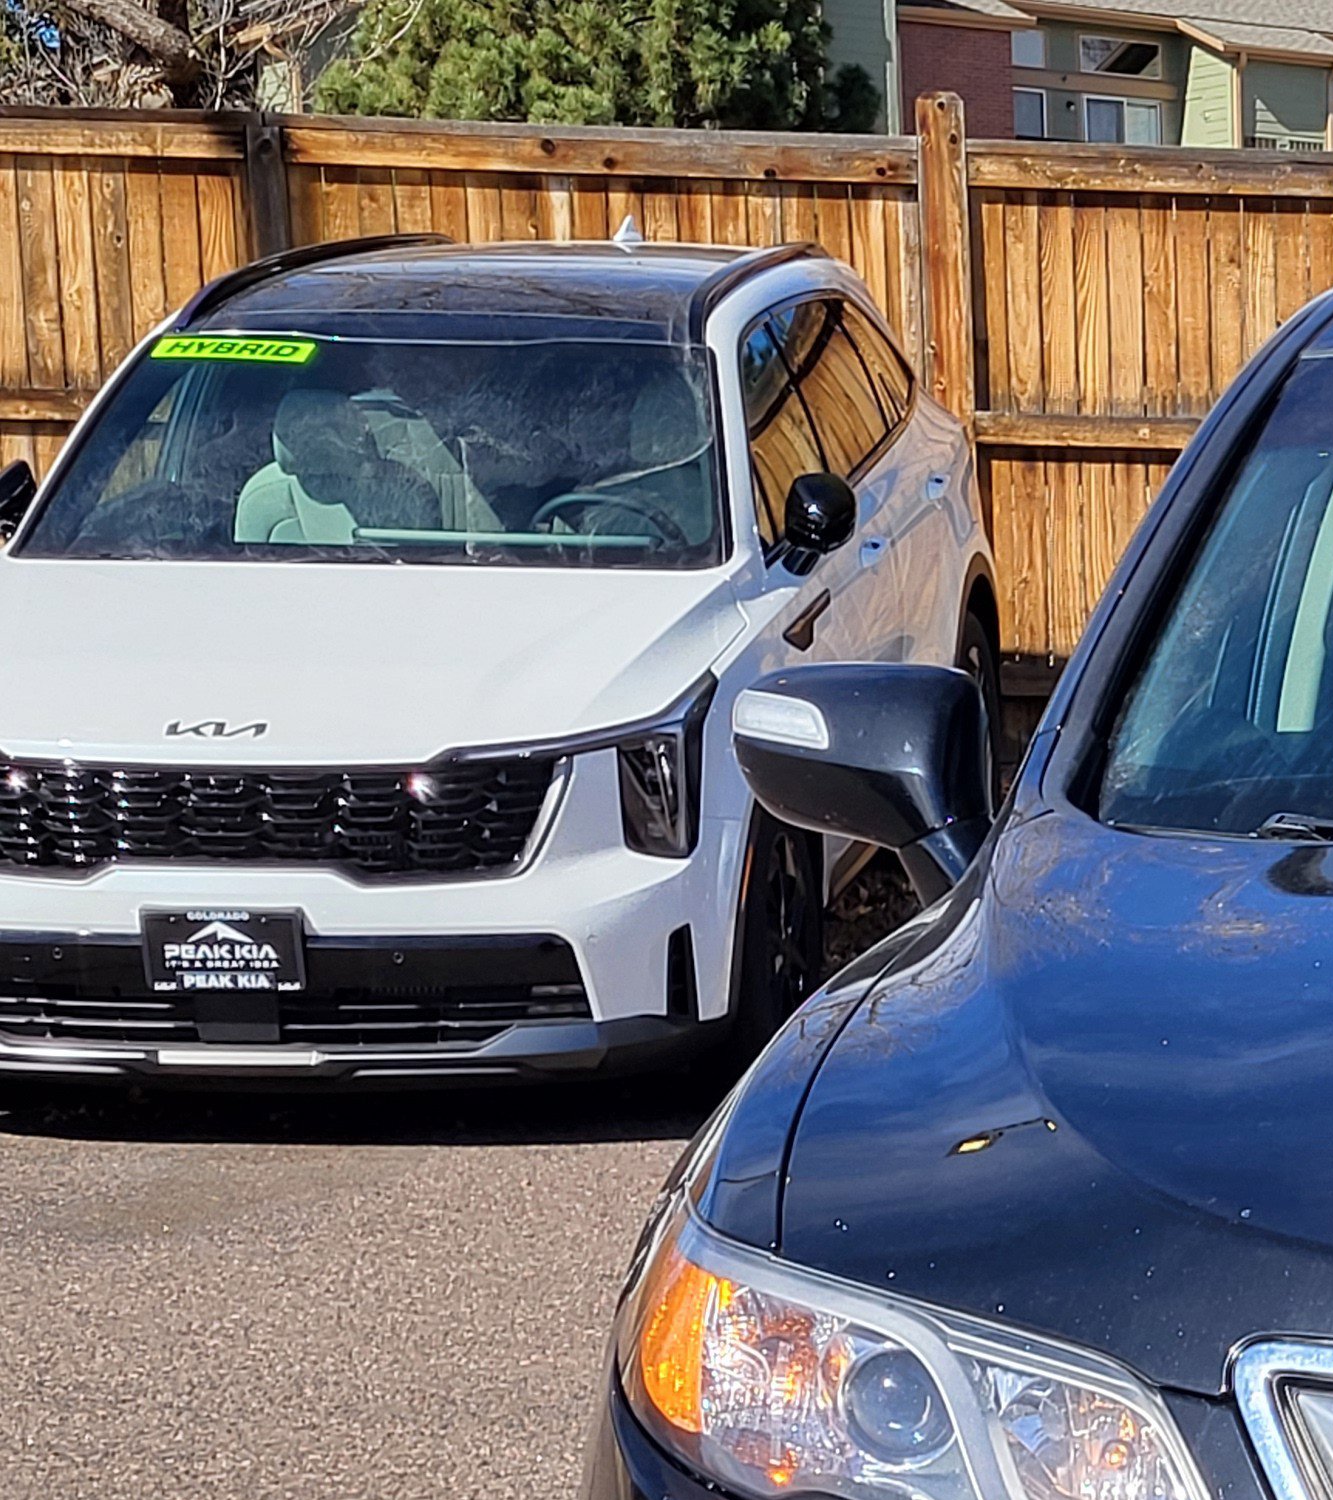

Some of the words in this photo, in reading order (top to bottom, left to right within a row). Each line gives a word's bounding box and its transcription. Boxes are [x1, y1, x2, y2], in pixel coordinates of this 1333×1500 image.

[166, 341, 301, 357] HYBRID
[165, 720, 268, 738] KIA
[186, 911, 250, 922] COLORADO
[163, 944, 233, 960] PEAK
[234, 944, 278, 960] KIA
[183, 974, 236, 989] PEAK
[237, 974, 271, 989] KIA
